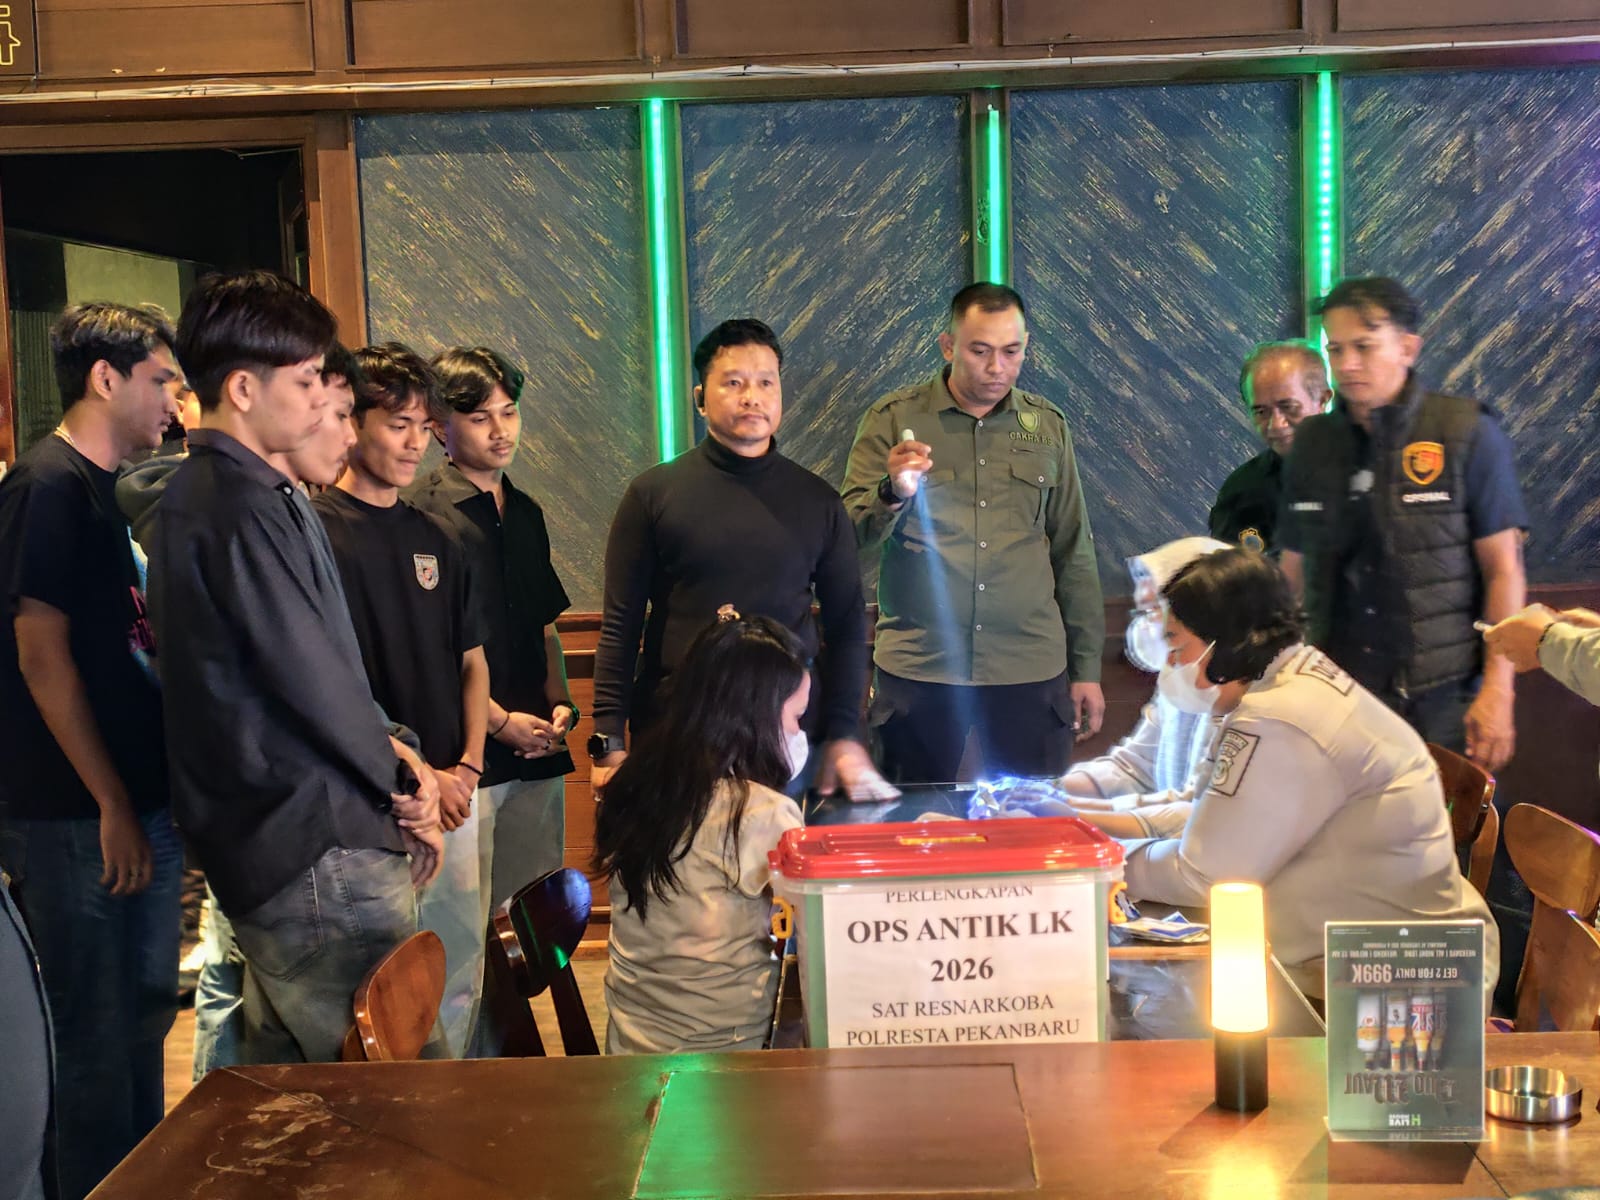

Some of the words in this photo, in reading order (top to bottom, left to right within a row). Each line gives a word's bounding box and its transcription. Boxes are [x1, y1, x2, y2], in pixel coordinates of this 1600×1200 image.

[886, 885, 1033, 903] PERLENGKAPAN
[847, 920, 908, 944] OPS
[916, 914, 1020, 941] ANTIK
[1029, 910, 1073, 935] LK
[930, 957, 994, 983] 2026
[1351, 963, 1393, 984] 999K
[1395, 967, 1417, 979] ONLY
[1418, 967, 1433, 979] FOR
[1436, 967, 1441, 979] 2
[1443, 967, 1458, 979] GET
[871, 1001, 909, 1019] SAT
[914, 993, 1055, 1018] RESNARKOBA
[846, 1027, 950, 1047] POLRESTA
[954, 1018, 1081, 1044] PEKANBARU
[1389, 1119, 1410, 1127] LIVE
